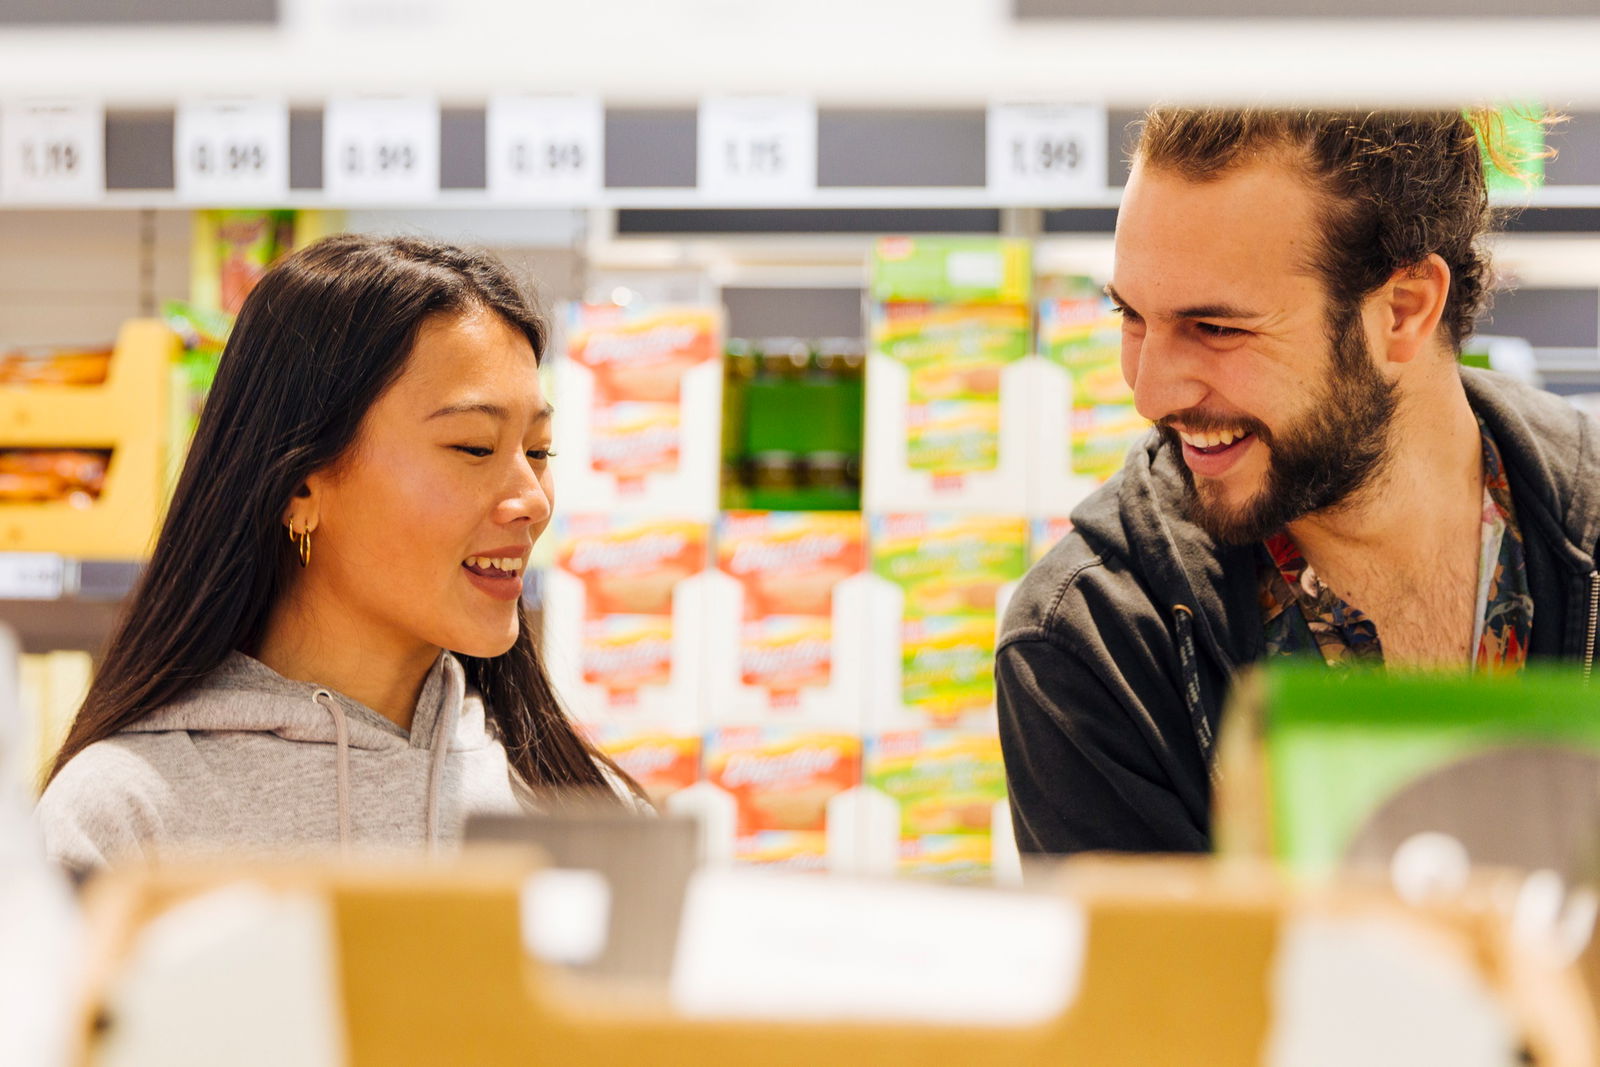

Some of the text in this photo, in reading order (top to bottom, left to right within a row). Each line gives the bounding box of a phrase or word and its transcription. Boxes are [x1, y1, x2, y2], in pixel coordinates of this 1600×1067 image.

[194, 138, 266, 177] 0.99
[341, 138, 416, 177] 0.99
[510, 138, 586, 178] 0.99
